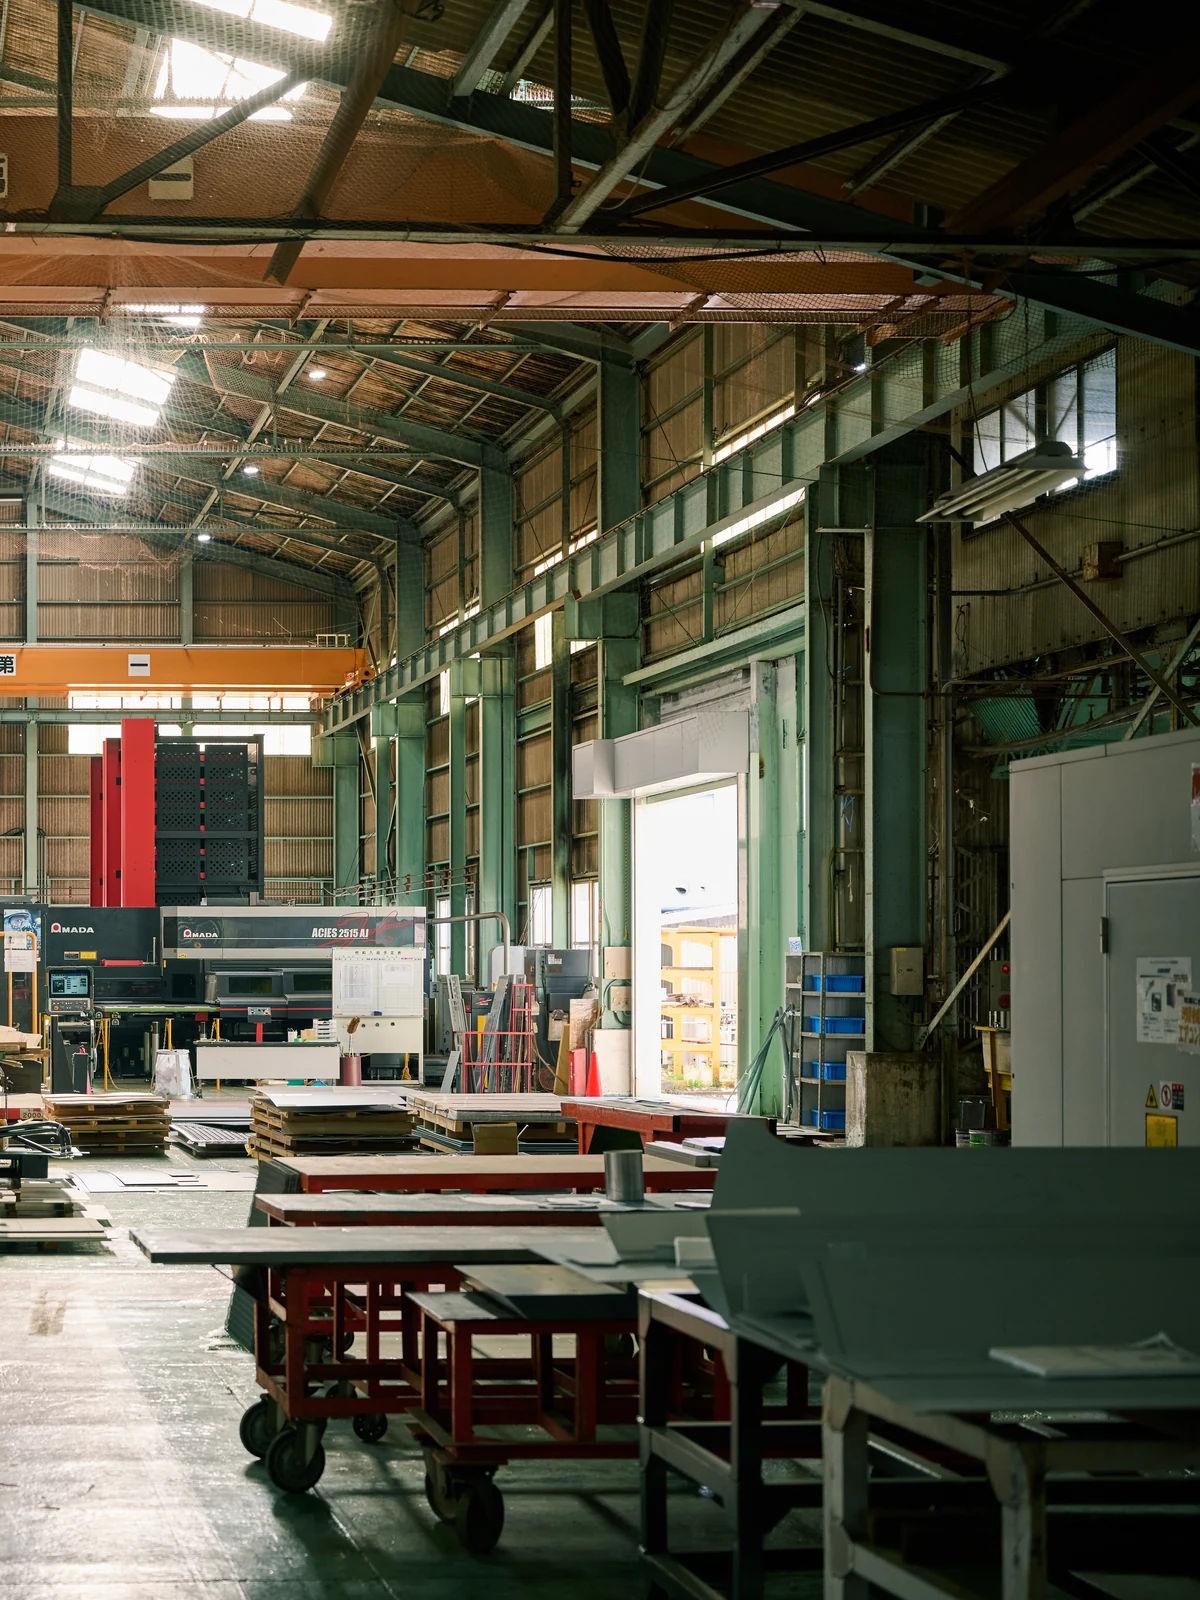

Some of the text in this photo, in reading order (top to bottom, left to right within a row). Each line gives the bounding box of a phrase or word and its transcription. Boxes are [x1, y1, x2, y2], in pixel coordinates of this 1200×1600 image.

[51, 922, 95, 934] AMADA
[184, 929, 219, 938] AMADA
[311, 927, 338, 938] ACIES
[338, 927, 359, 938] 2515
